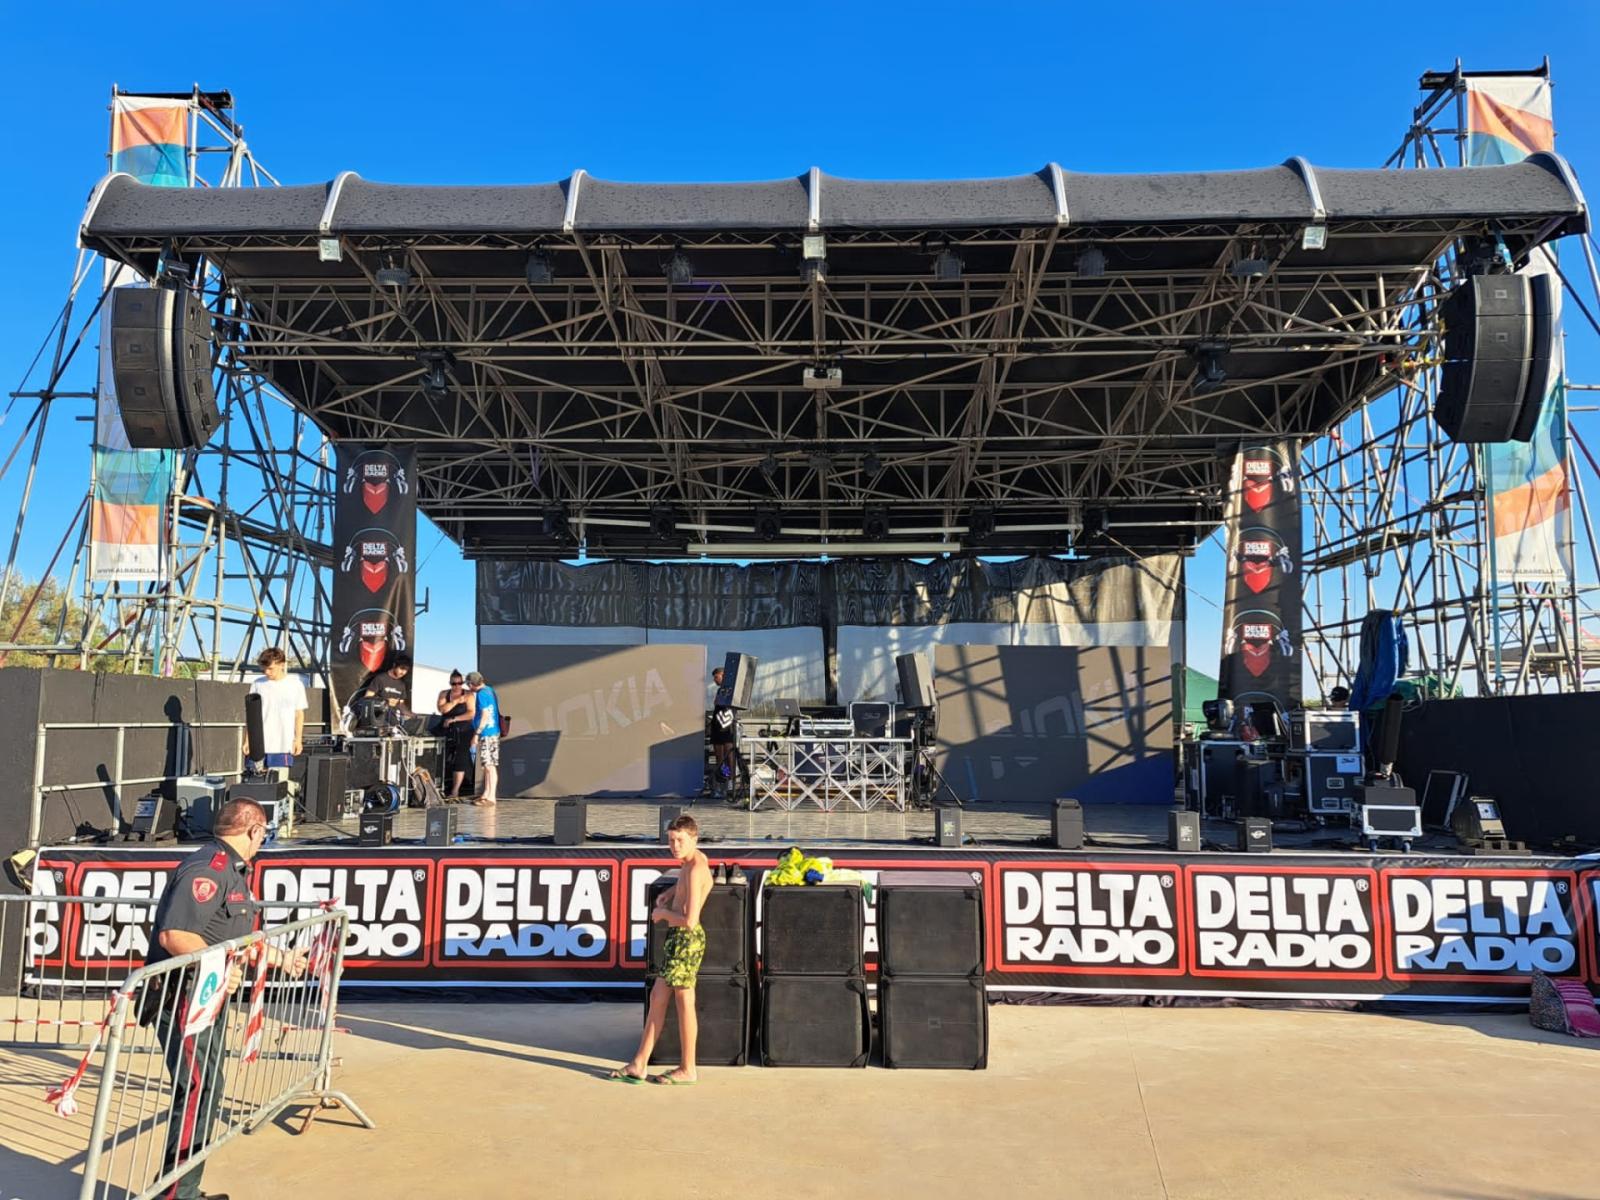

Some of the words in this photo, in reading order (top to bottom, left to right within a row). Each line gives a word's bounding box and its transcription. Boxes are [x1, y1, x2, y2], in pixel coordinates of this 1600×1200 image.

[445, 923, 607, 957] RADIO
[1006, 927, 1175, 964] RADIO
[1200, 931, 1371, 969] RADIO
[1396, 935, 1576, 973] RADIO
